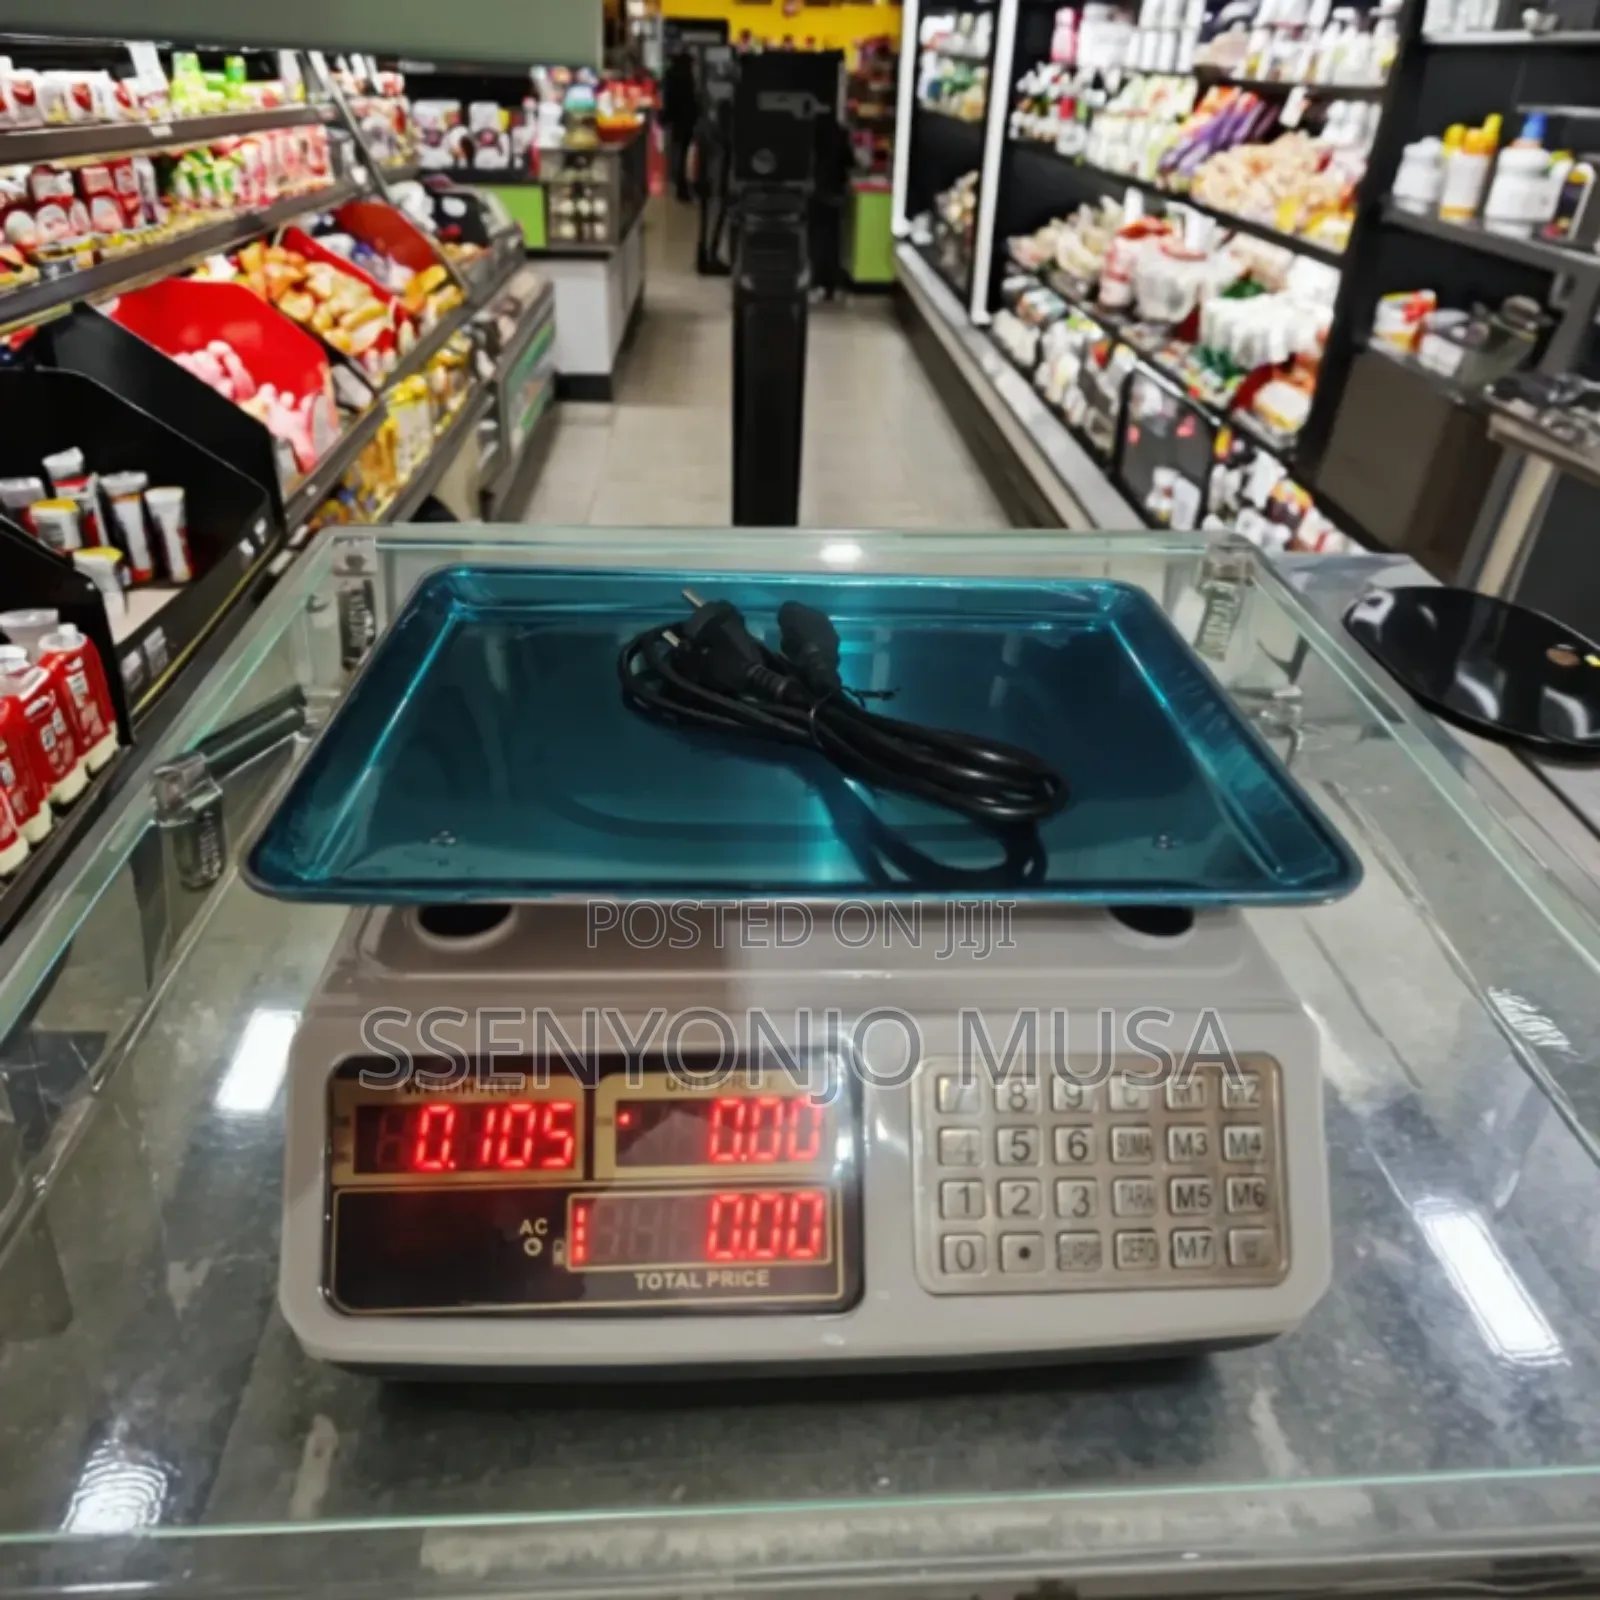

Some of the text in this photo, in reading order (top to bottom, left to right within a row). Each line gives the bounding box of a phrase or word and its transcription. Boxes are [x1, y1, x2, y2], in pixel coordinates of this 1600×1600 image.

[1009, 1080, 1027, 1112] 8
[1064, 1078, 1083, 1109] 9
[414, 1102, 574, 1170] 0.105
[709, 1098, 822, 1163] 0.00
[1011, 1130, 1031, 1162] 5
[1068, 1130, 1088, 1161] 6
[1174, 1131, 1208, 1156] M3
[1229, 1132, 1262, 1156] M4
[958, 1185, 970, 1214] 1
[1011, 1184, 1031, 1215] 2
[1072, 1185, 1090, 1218] 3
[1176, 1185, 1212, 1209] M5
[1232, 1182, 1266, 1208] M6
[519, 1219, 548, 1235] AC
[955, 1239, 976, 1270] 0
[1177, 1237, 1212, 1261] M7
[634, 1271, 770, 1290] TOTAL PRICE
